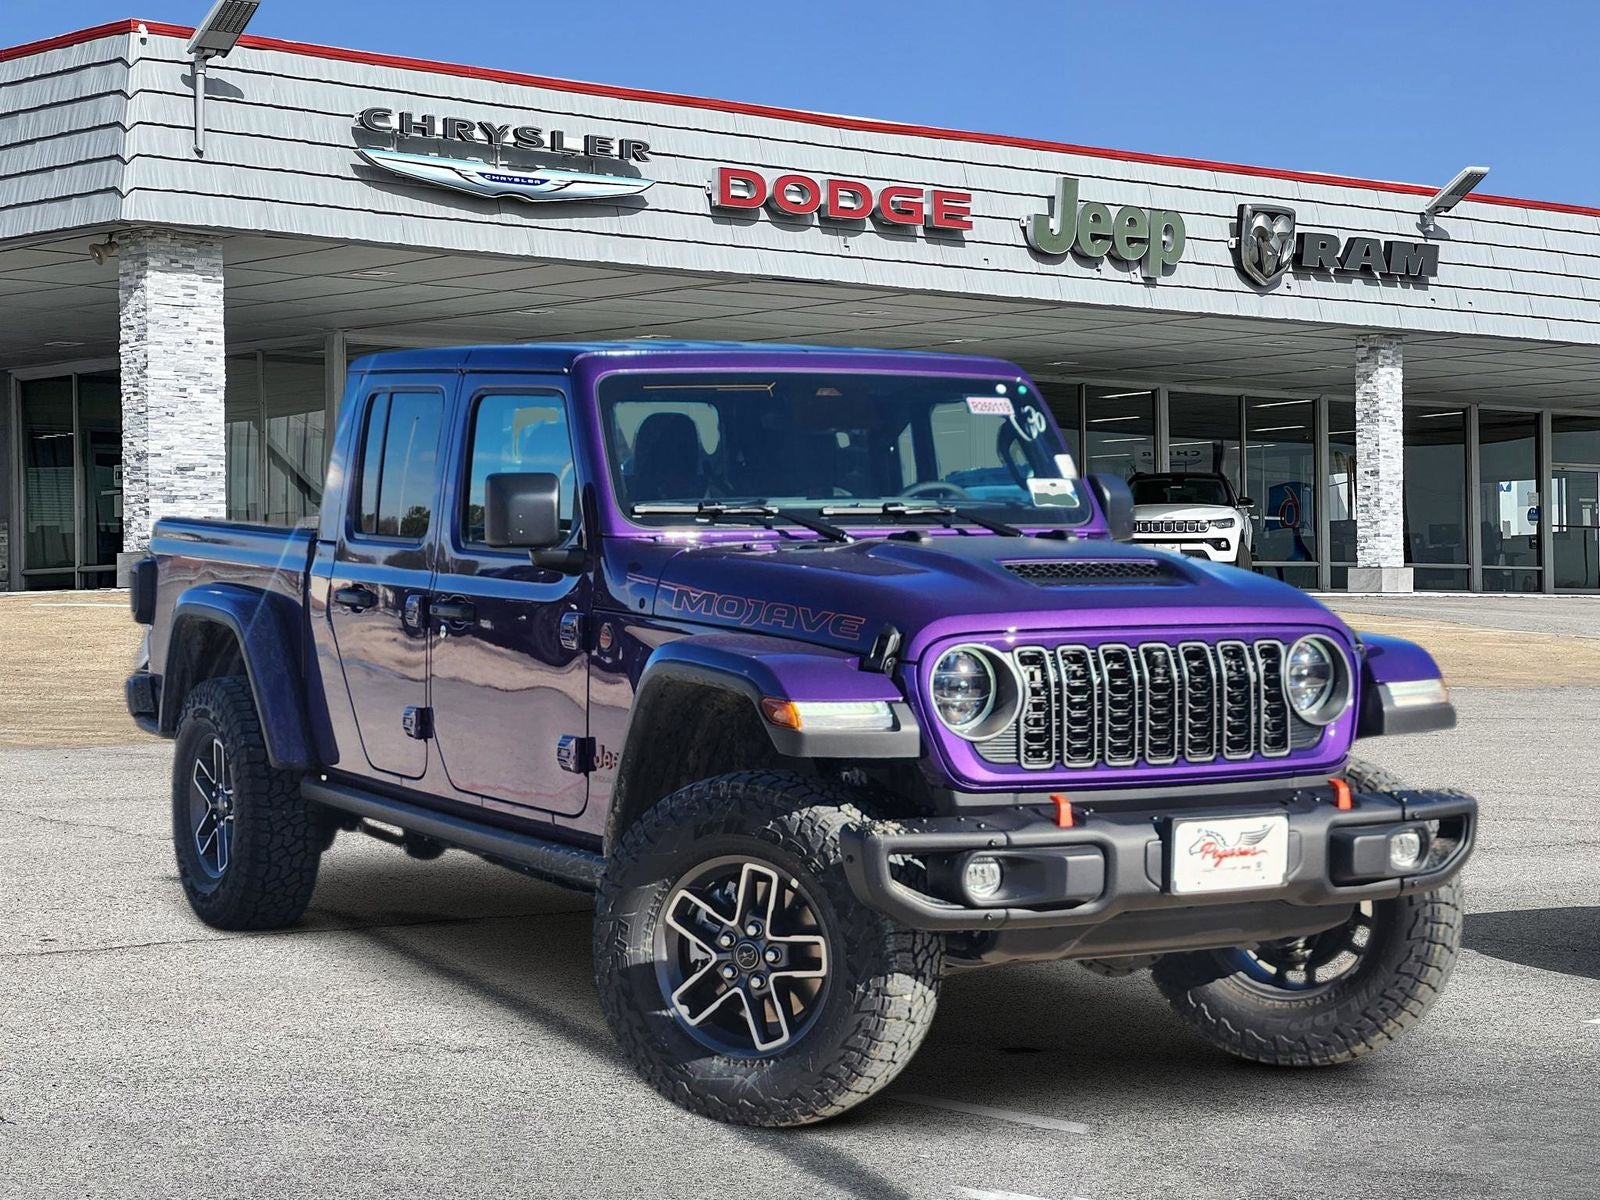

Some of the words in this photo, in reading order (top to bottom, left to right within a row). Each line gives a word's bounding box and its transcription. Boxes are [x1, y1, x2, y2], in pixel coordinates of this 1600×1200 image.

[358, 106, 651, 163] CHRYSLER
[484, 174, 541, 185] CHRYSLER
[712, 166, 974, 231] DODGE
[1027, 177, 1186, 279] Jeep
[1300, 231, 1440, 278] RAM
[672, 586, 866, 641] MOJAVE
[594, 745, 620, 770] Jee
